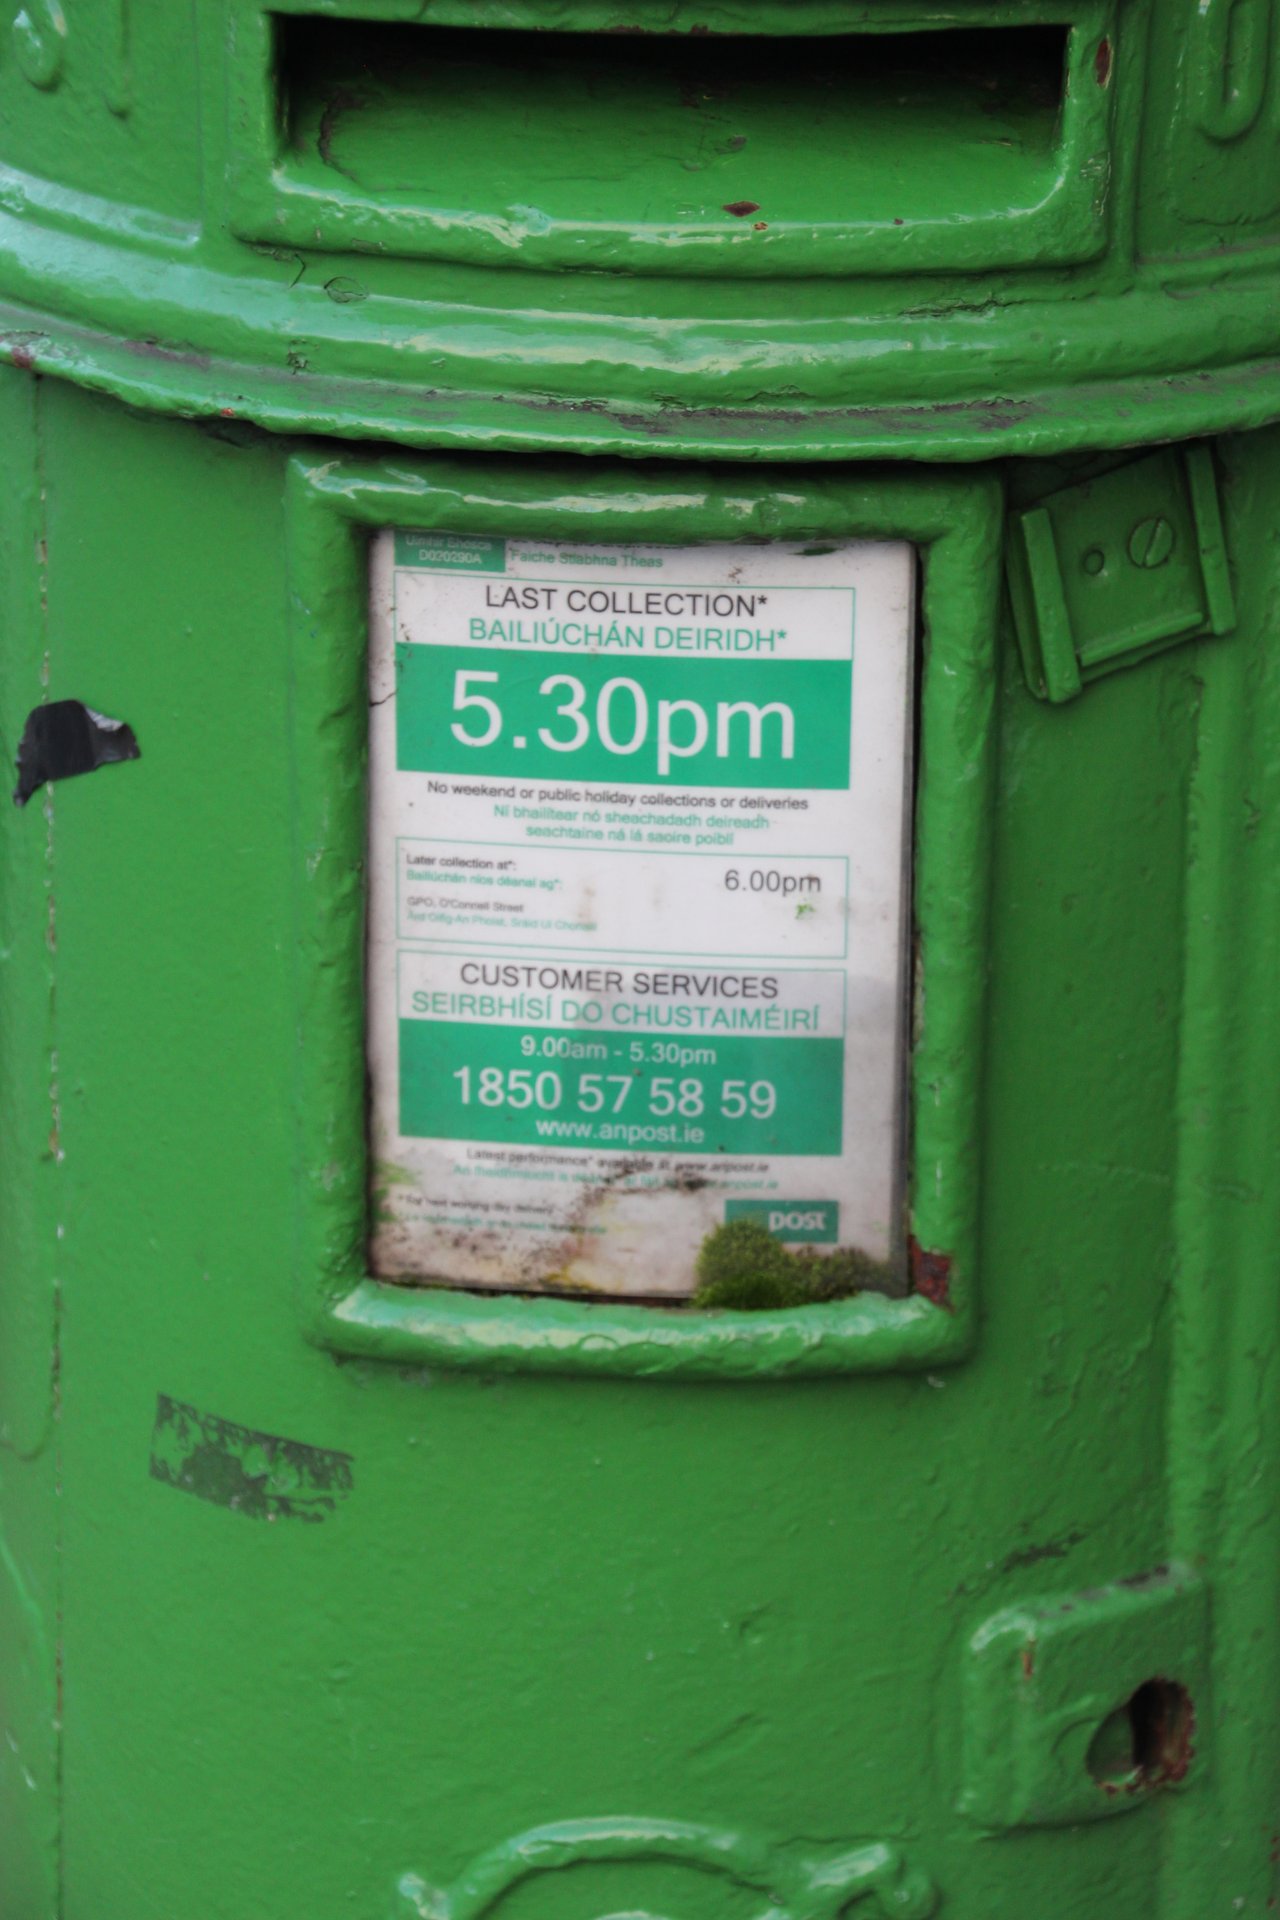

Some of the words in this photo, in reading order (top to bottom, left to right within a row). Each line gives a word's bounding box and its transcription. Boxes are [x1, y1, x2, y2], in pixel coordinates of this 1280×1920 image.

[622, 554, 664, 568] Theas
[485, 585, 557, 611] LAST
[468, 616, 644, 648] BAILIÚCHÁN
[450, 669, 795, 776] 5.30pm
[427, 780, 447, 794] No
[452, 783, 515, 799] weekend
[519, 788, 533, 799] or
[538, 787, 581, 804] public
[585, 789, 635, 807] holiday
[640, 792, 716, 809] collections
[720, 798, 735, 809] or
[739, 795, 808, 811] deliveries
[494, 803, 509, 818] Ní
[583, 809, 600, 822] nó
[605, 811, 701, 828] sheachadadh
[706, 813, 769, 830] deireadh
[526, 823, 603, 842] seachtaine
[608, 827, 625, 842] ná
[647, 831, 691, 845] saoire
[695, 831, 734, 847] poiblí
[406, 855, 436, 866] Later
[439, 857, 494, 870] collection
[724, 869, 821, 897] 6.00pm
[492, 901, 524, 913] Street
[460, 963, 623, 993] CUSTOMER
[633, 971, 778, 998] SERVICES
[411, 991, 552, 1020] SEIRBHÍSÍ
[561, 999, 603, 1024] DO
[611, 1001, 819, 1030] CHUSTAIMÉIRÍ
[521, 1035, 606, 1060] 9.00am
[629, 1042, 717, 1067] 5.30pm
[453, 1065, 562, 1109] 1850
[578, 1074, 633, 1113] 57
[648, 1078, 705, 1117] 58
[720, 1080, 777, 1119] 59
[536, 1117, 705, 1145] www.anpost.ie
[467, 1149, 505, 1161] Latest
